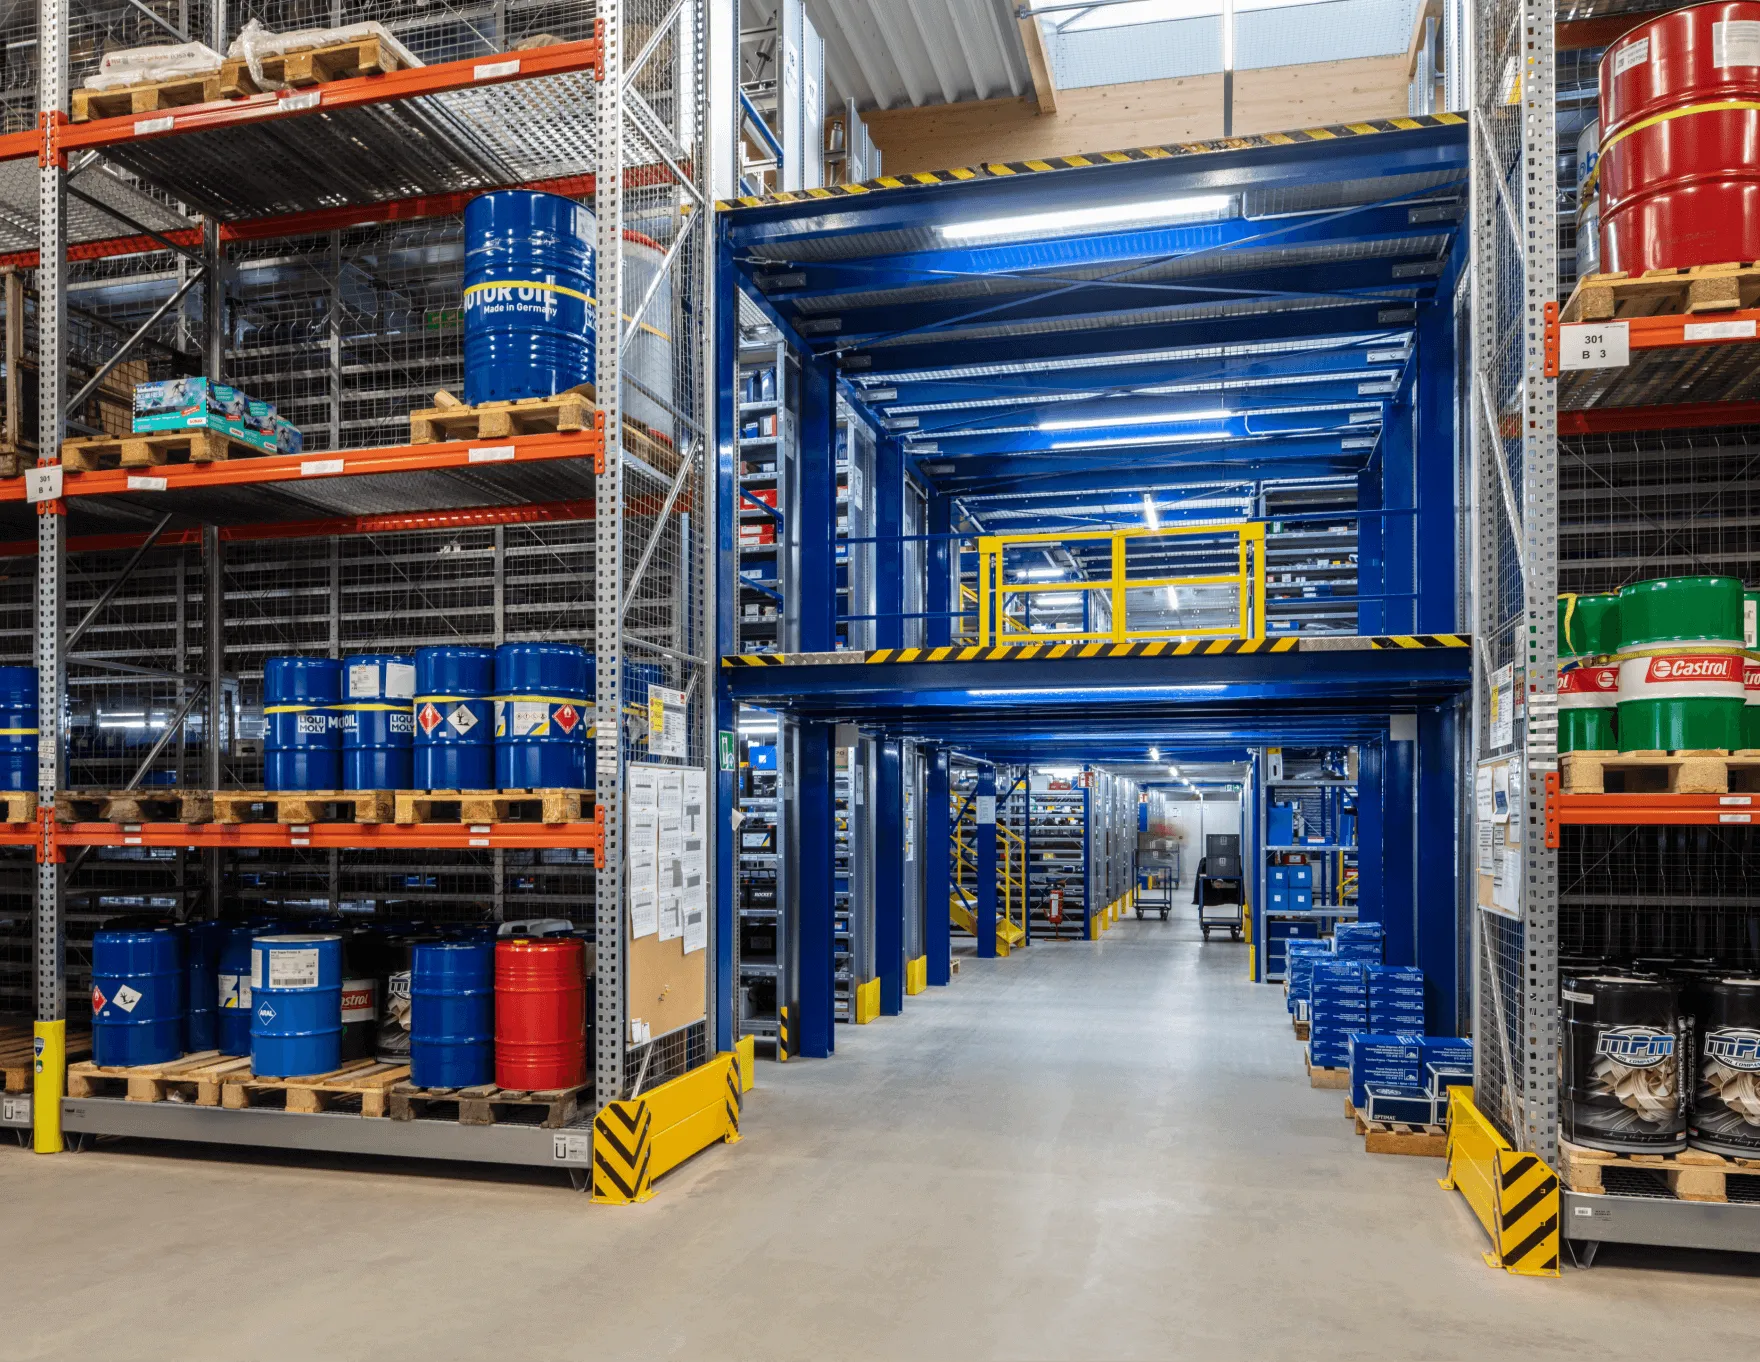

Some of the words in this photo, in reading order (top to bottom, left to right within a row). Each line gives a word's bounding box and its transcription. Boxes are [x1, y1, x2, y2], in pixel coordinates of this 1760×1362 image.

[518, 281, 557, 305] OIL
[484, 304, 503, 314] Made
[506, 303, 513, 312] in
[517, 303, 558, 316] Germany
[1585, 335, 1603, 344] 301
[1582, 351, 1590, 359] B
[1600, 350, 1607, 358] 3
[1672, 660, 1727, 677] Castrol
[300, 715, 324, 725] LIQUI
[300, 725, 324, 734] MOLY
